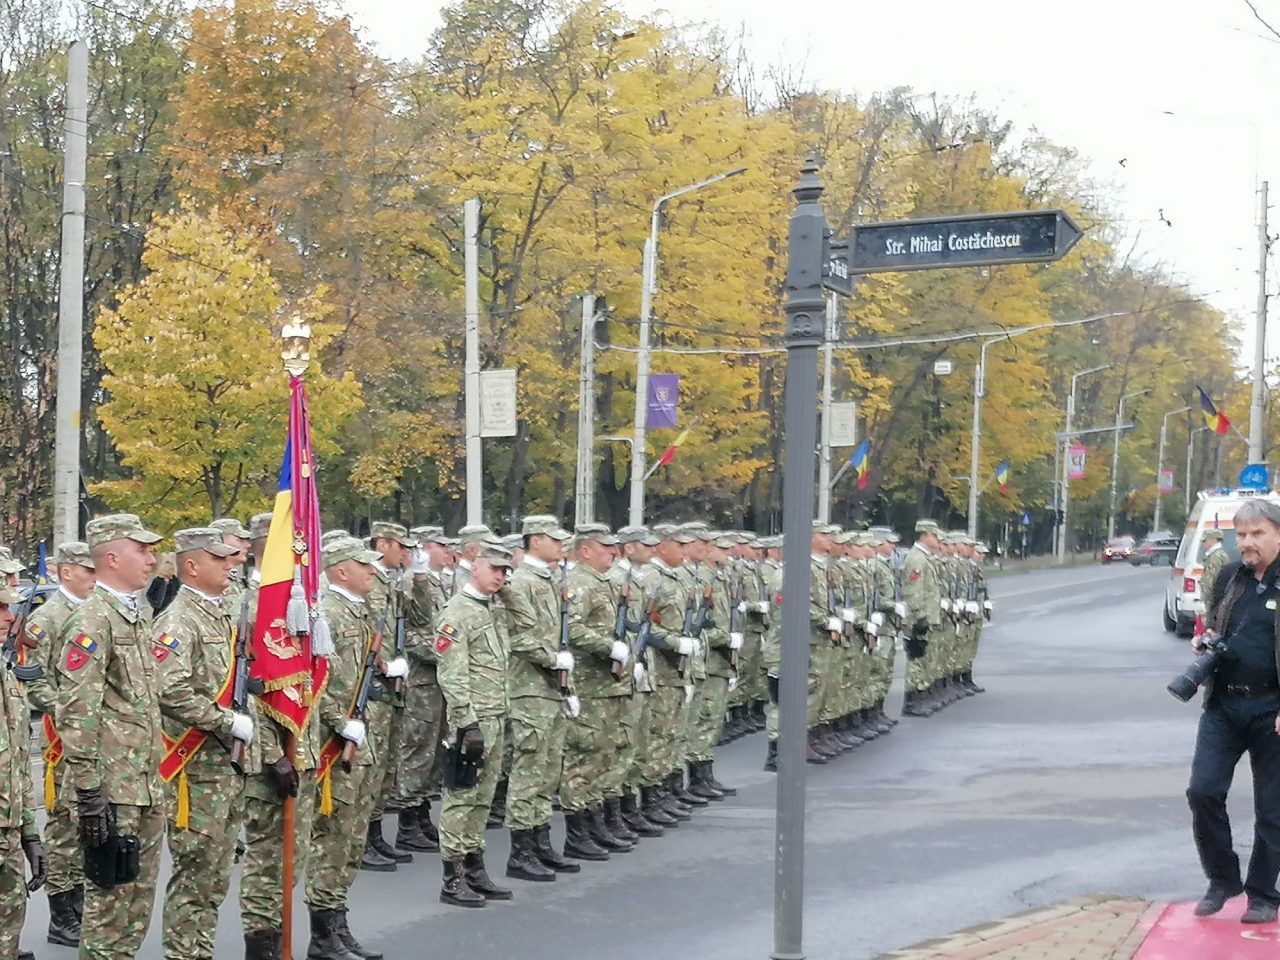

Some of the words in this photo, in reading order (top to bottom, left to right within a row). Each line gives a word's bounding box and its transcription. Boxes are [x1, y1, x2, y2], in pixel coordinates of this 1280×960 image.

[885, 239, 906, 255] Str.
[910, 234, 943, 253] Mihai
[948, 231, 1020, 250] Costăchescu
